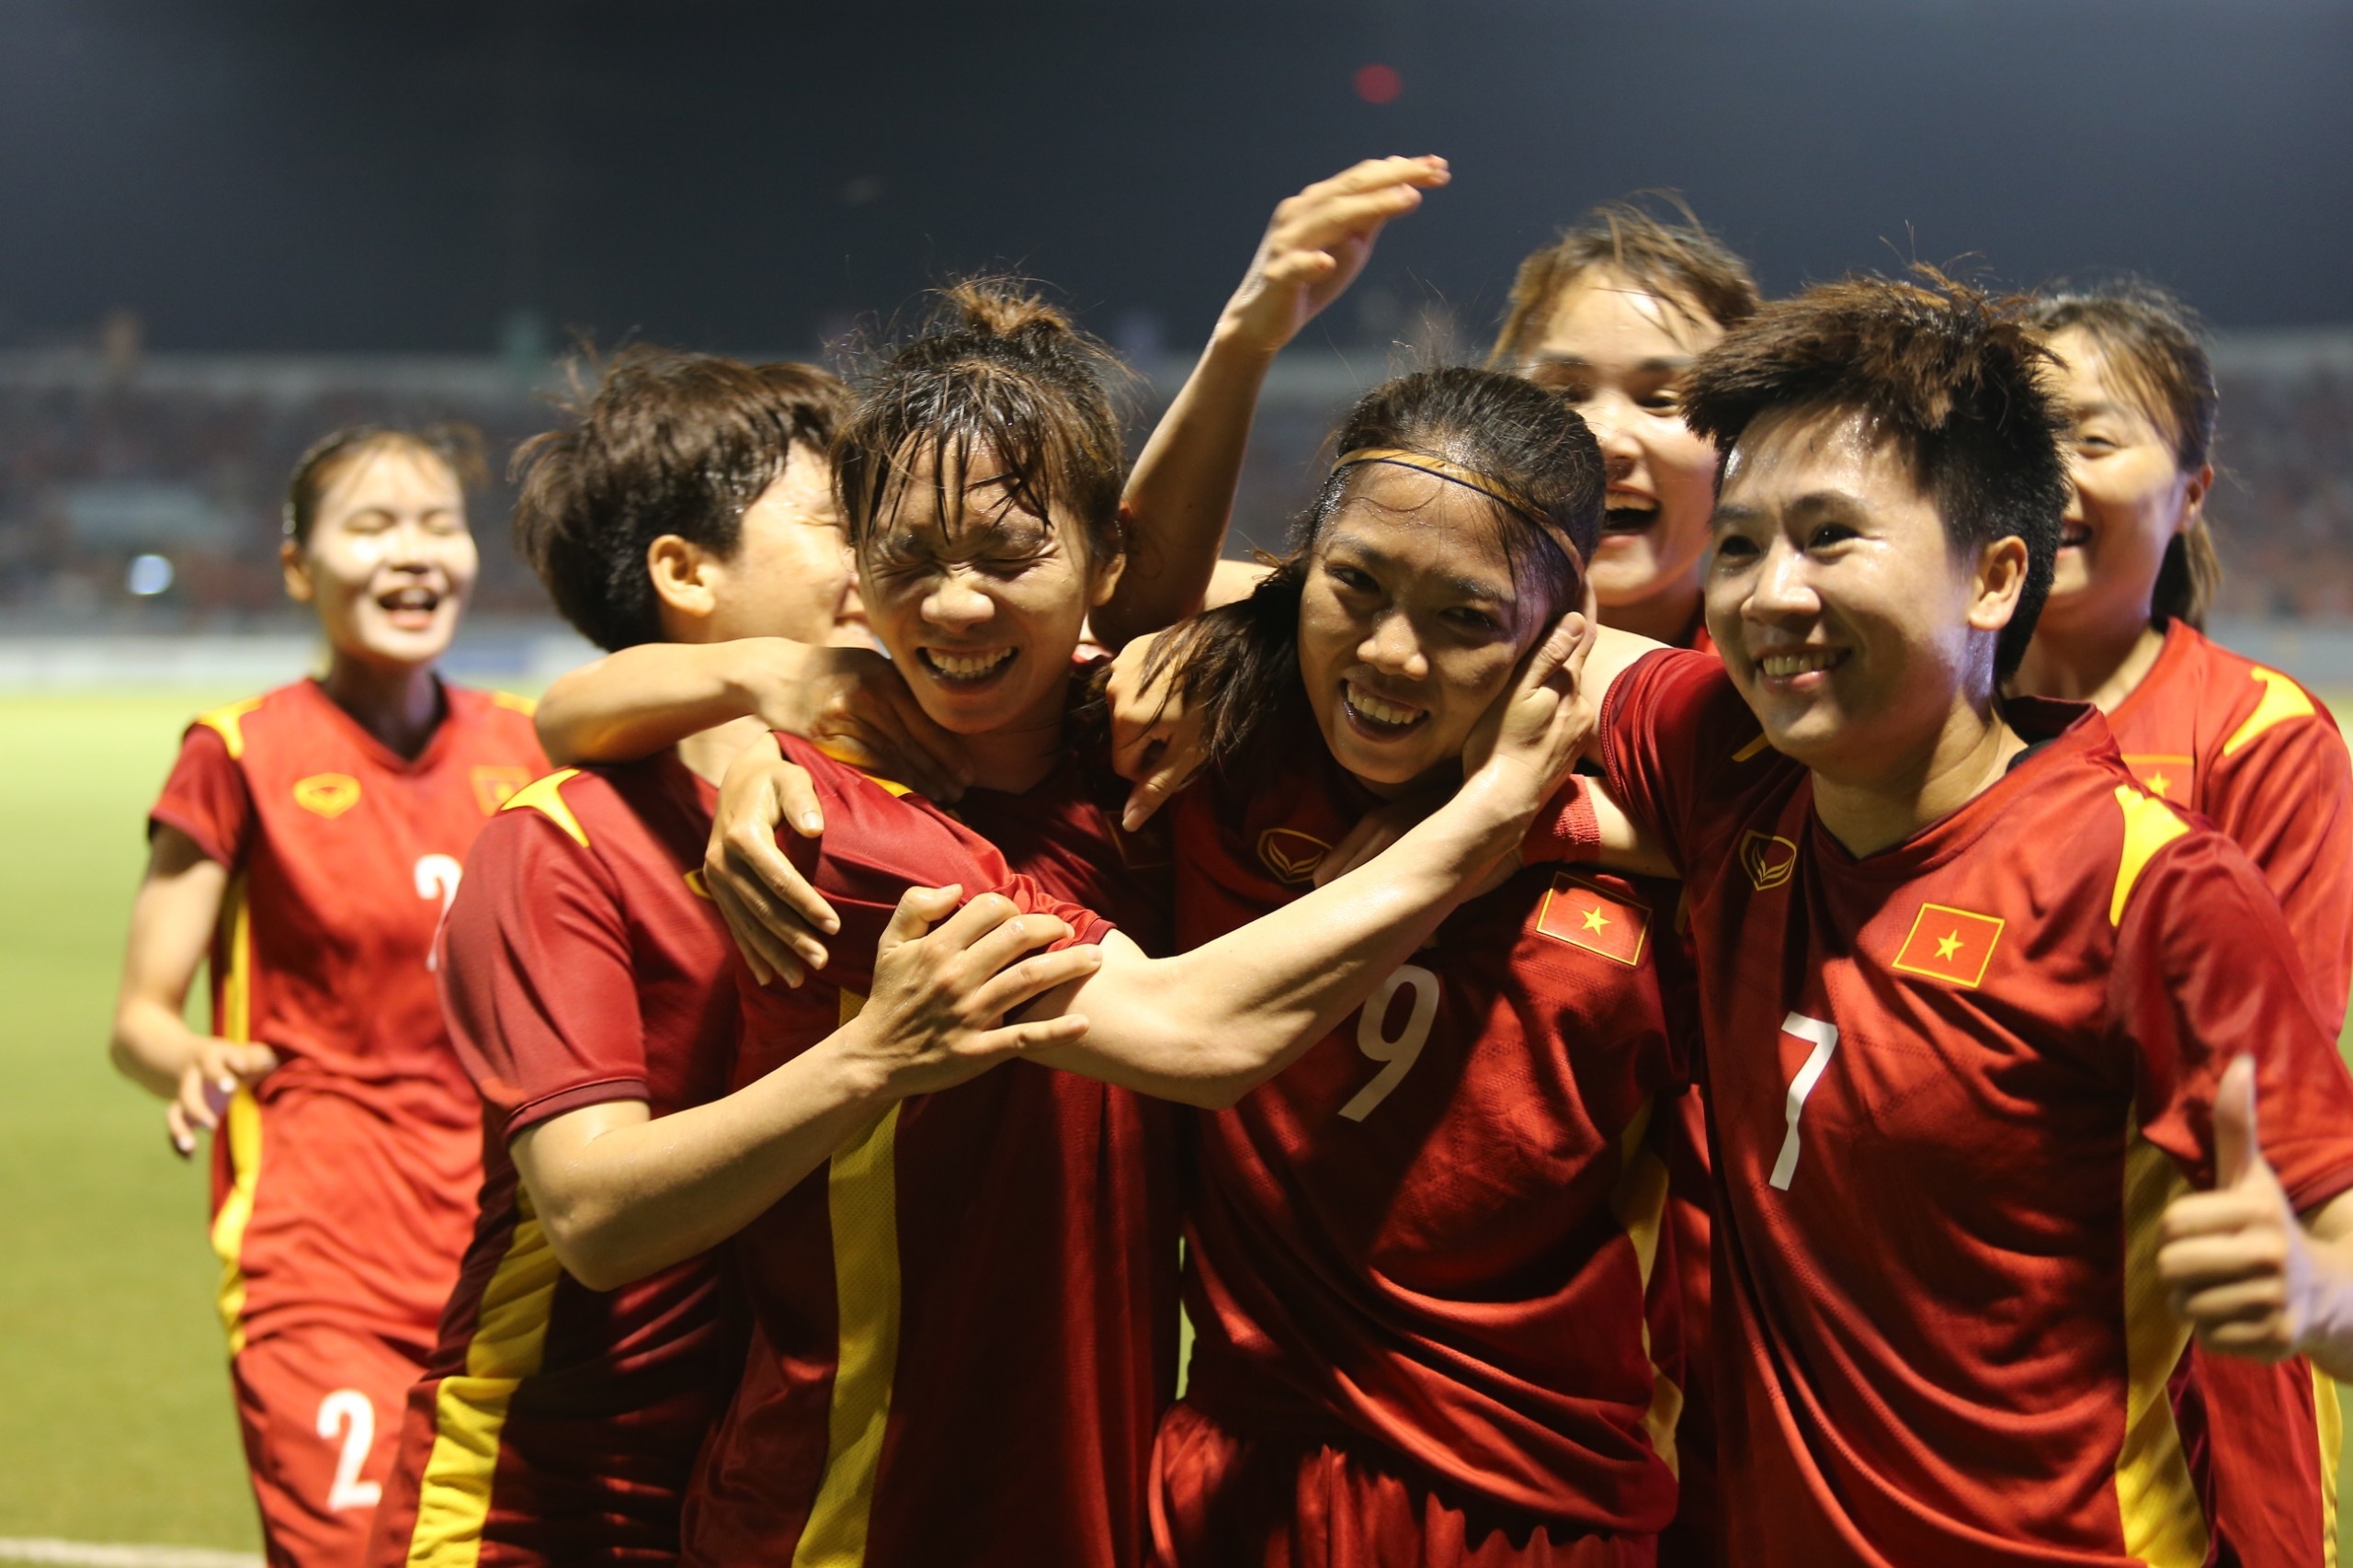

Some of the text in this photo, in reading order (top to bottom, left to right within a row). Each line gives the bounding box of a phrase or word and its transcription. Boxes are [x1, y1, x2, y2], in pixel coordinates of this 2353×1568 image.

[1338, 965, 1440, 1122] 9
[1769, 1012, 1837, 1191] 7
[317, 1390, 381, 1510] 2
